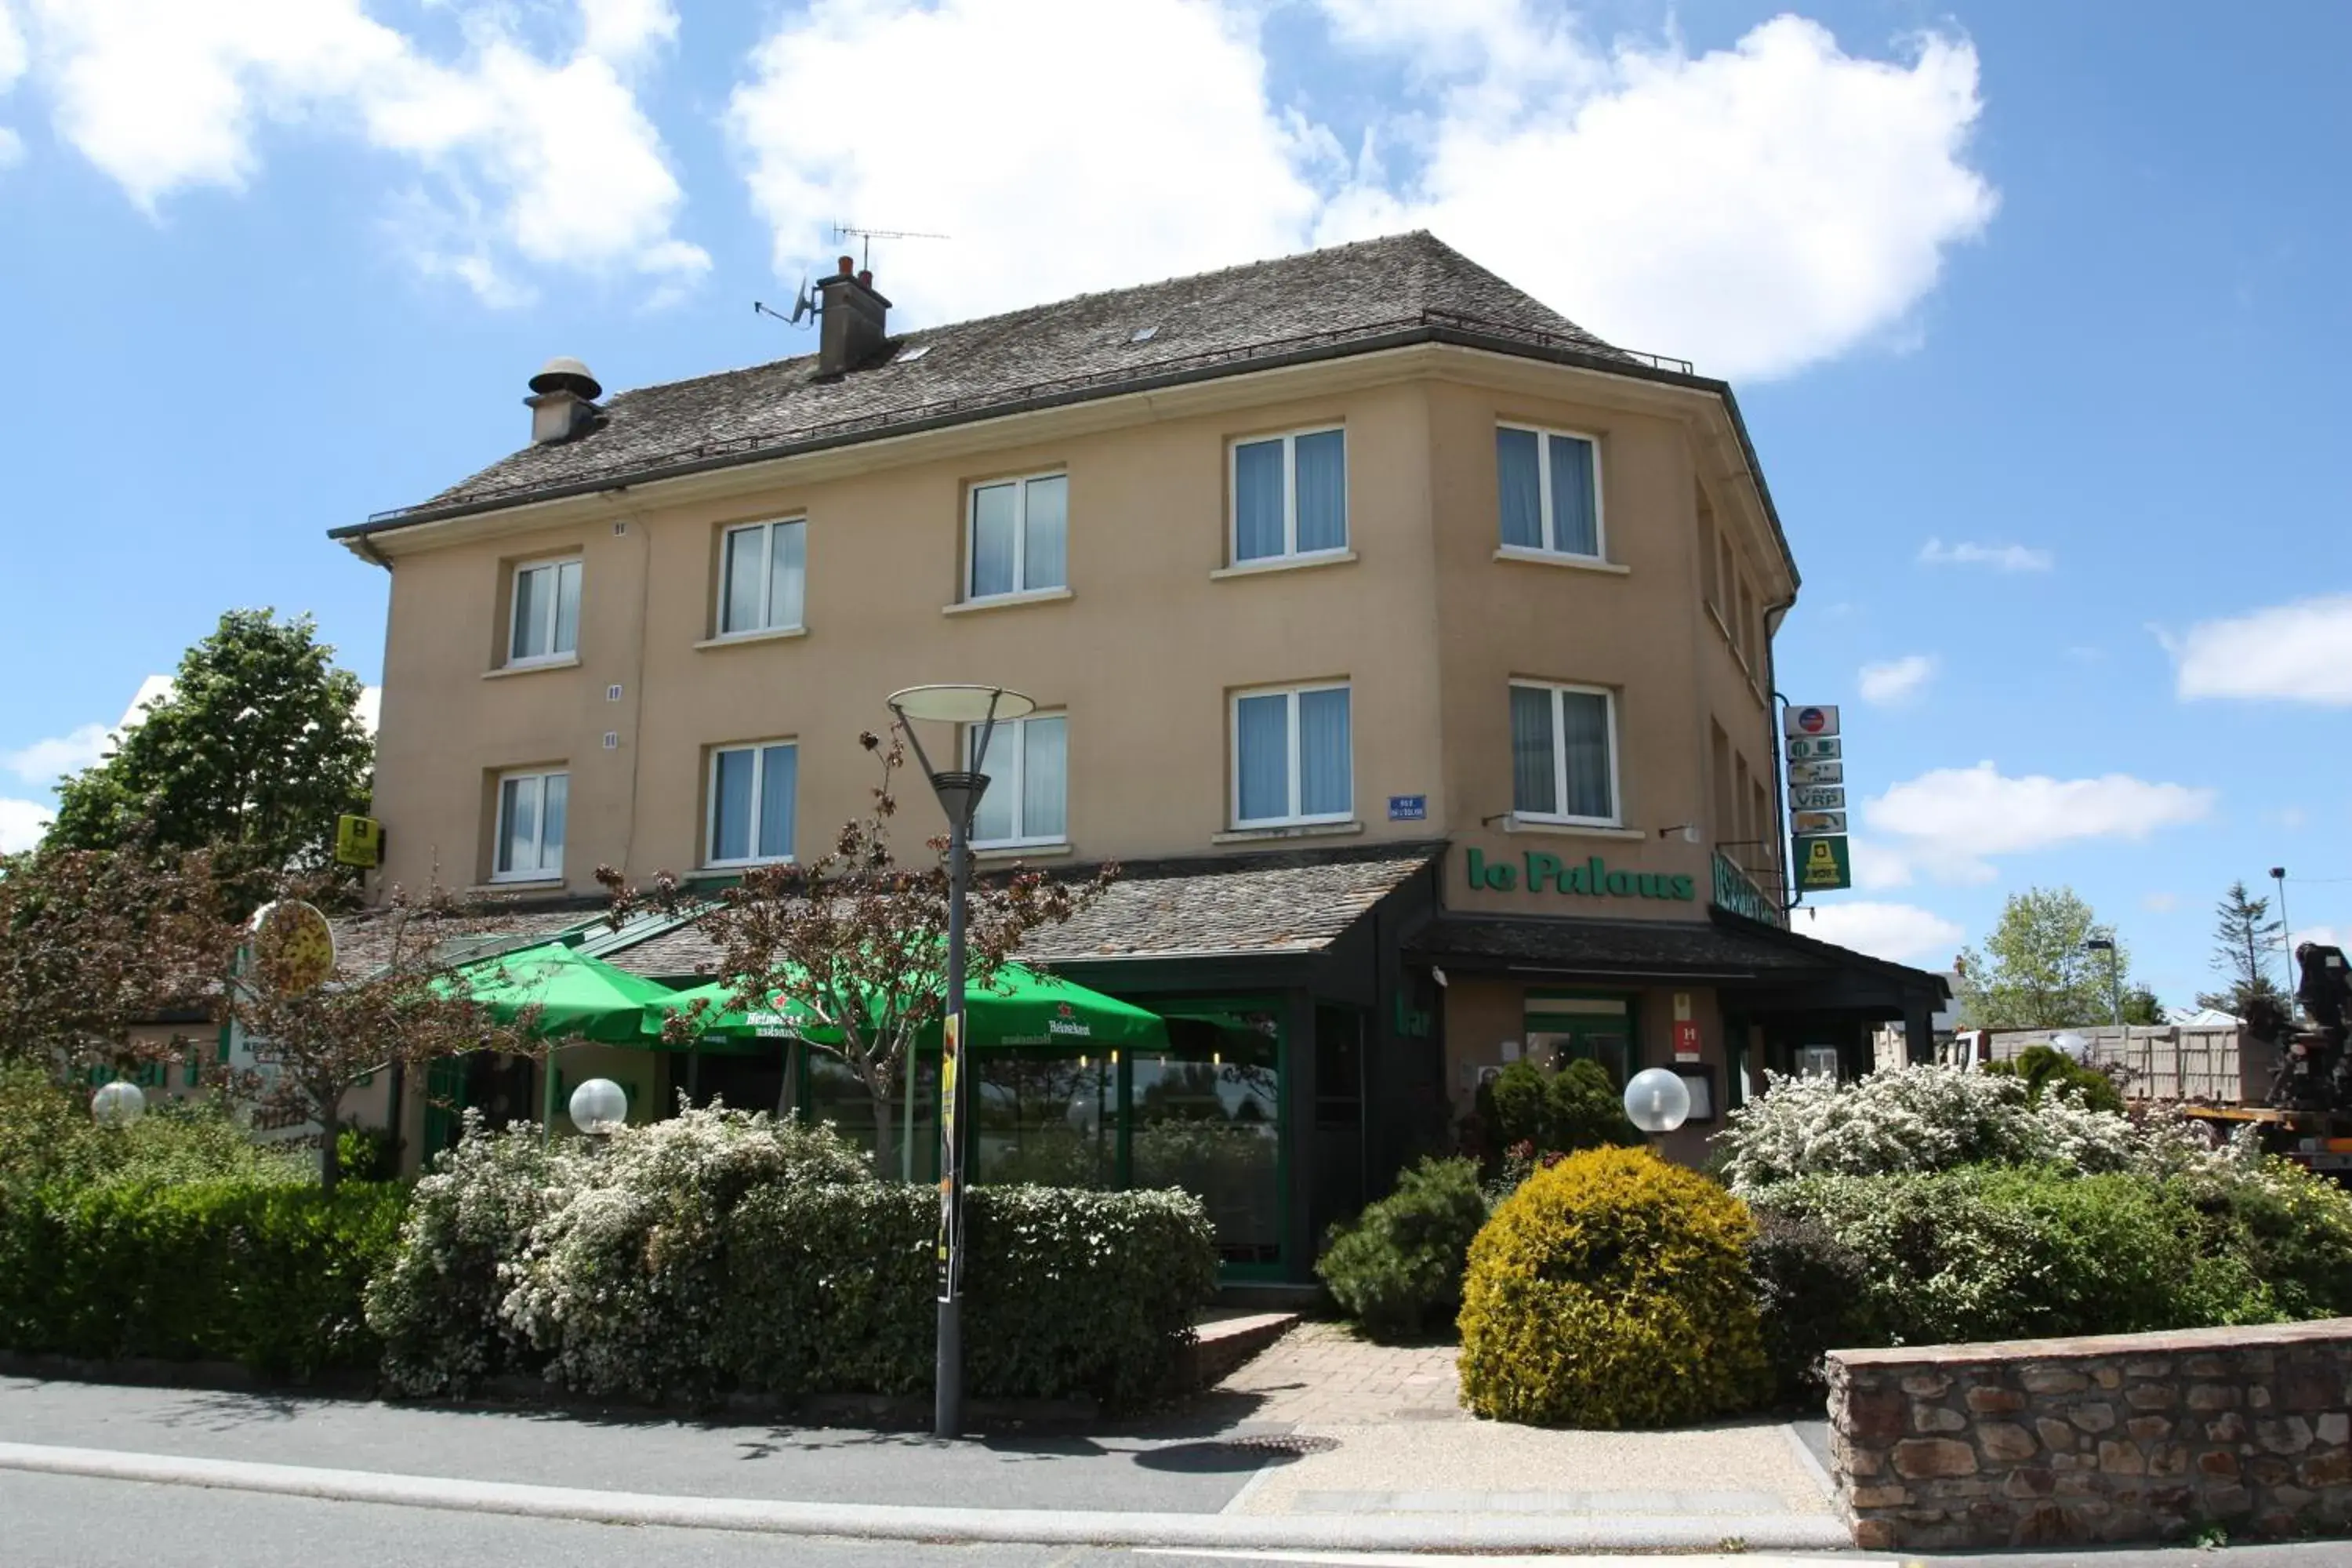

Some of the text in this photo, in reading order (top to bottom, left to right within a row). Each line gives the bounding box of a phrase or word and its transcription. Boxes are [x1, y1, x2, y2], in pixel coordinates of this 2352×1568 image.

[1797, 793, 1838, 806] VRP
[1467, 848, 1518, 892] le
[1524, 850, 1696, 902] Palous
[1396, 989, 1430, 1037] bar
[1683, 1028, 1697, 1041] H
